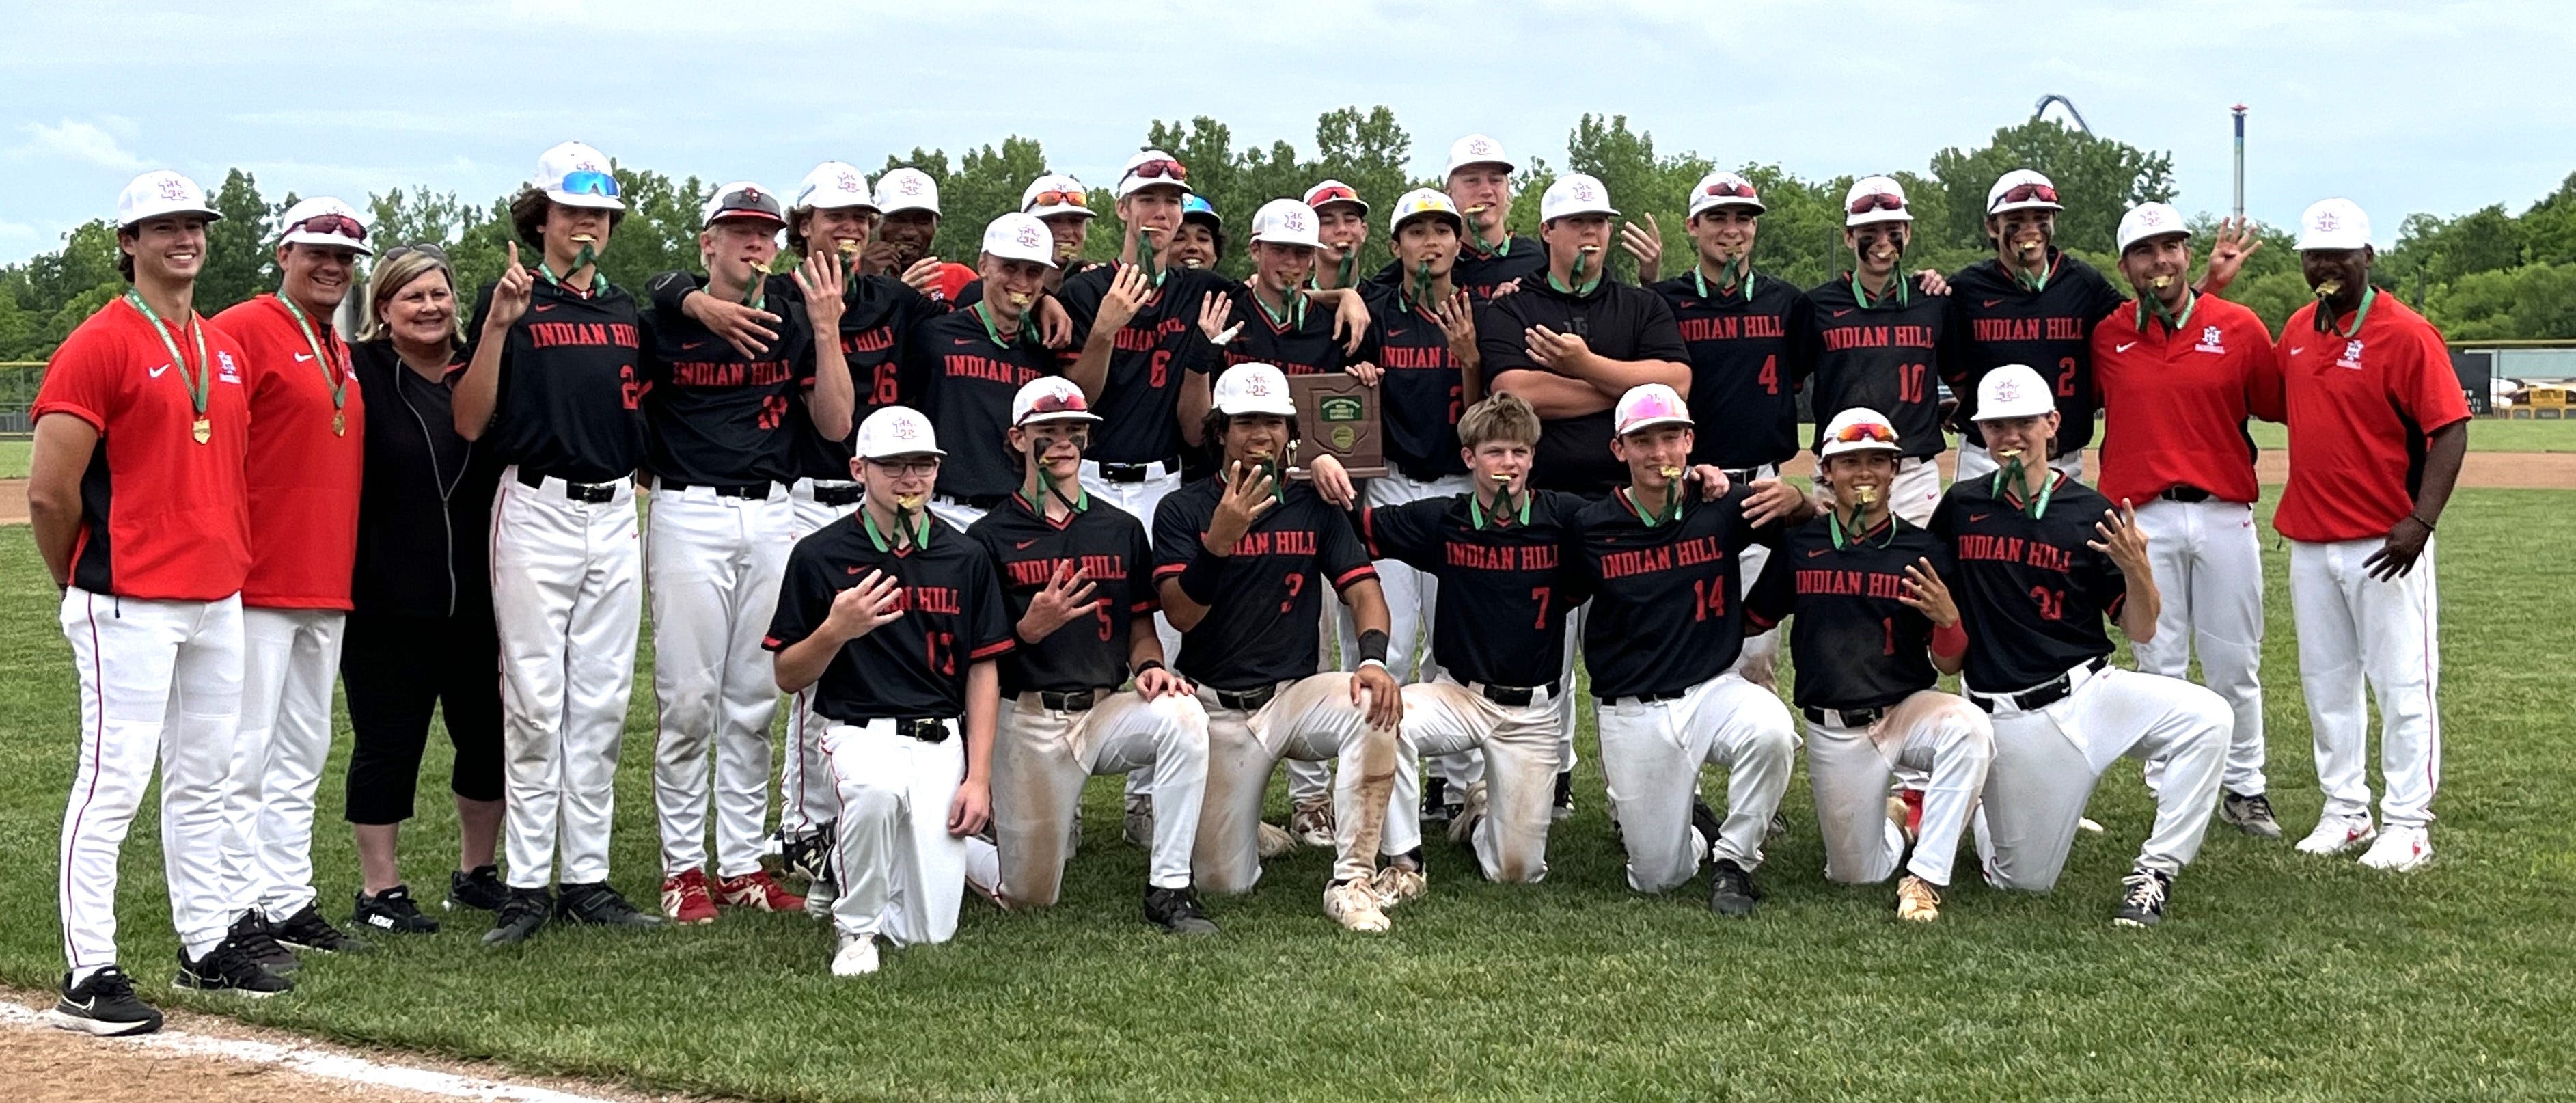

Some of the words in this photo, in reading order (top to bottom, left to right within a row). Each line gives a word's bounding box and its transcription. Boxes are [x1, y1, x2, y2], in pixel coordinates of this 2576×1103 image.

[529, 322, 609, 349] INDIAN
[609, 323, 640, 349] HIL
[1677, 316, 1738, 341] NDIAN
[1743, 314, 1785, 338] HILL
[1822, 325, 1889, 351] INDIAN
[1894, 325, 1934, 349] HILL
[1973, 318, 2040, 341] INDIAN
[2046, 317, 2083, 340] HILL
[673, 362, 745, 386] INDIAN
[750, 359, 792, 385] HILL
[868, 362, 898, 405] 16
[944, 354, 1014, 384] INDIAN
[1757, 353, 1779, 395] 4
[2057, 357, 2076, 397] 2
[1898, 364, 1926, 405] 10
[1275, 530, 1317, 556] HILL
[1446, 542, 1516, 571] INDIAN
[1521, 541, 1559, 570] HILL
[1601, 545, 1672, 580] INDIAN
[1675, 535, 1723, 567] HILL
[1958, 534, 2025, 562] INDIAN
[2027, 541, 2073, 574] HILL
[1078, 554, 1127, 581] HILL
[1796, 570, 1863, 595] INDIAN
[916, 586, 961, 615] HILL
[1532, 586, 1550, 629] 7
[1693, 575, 1725, 623] 14
[1096, 598, 1113, 642] 5
[1882, 616, 1894, 656] 1
